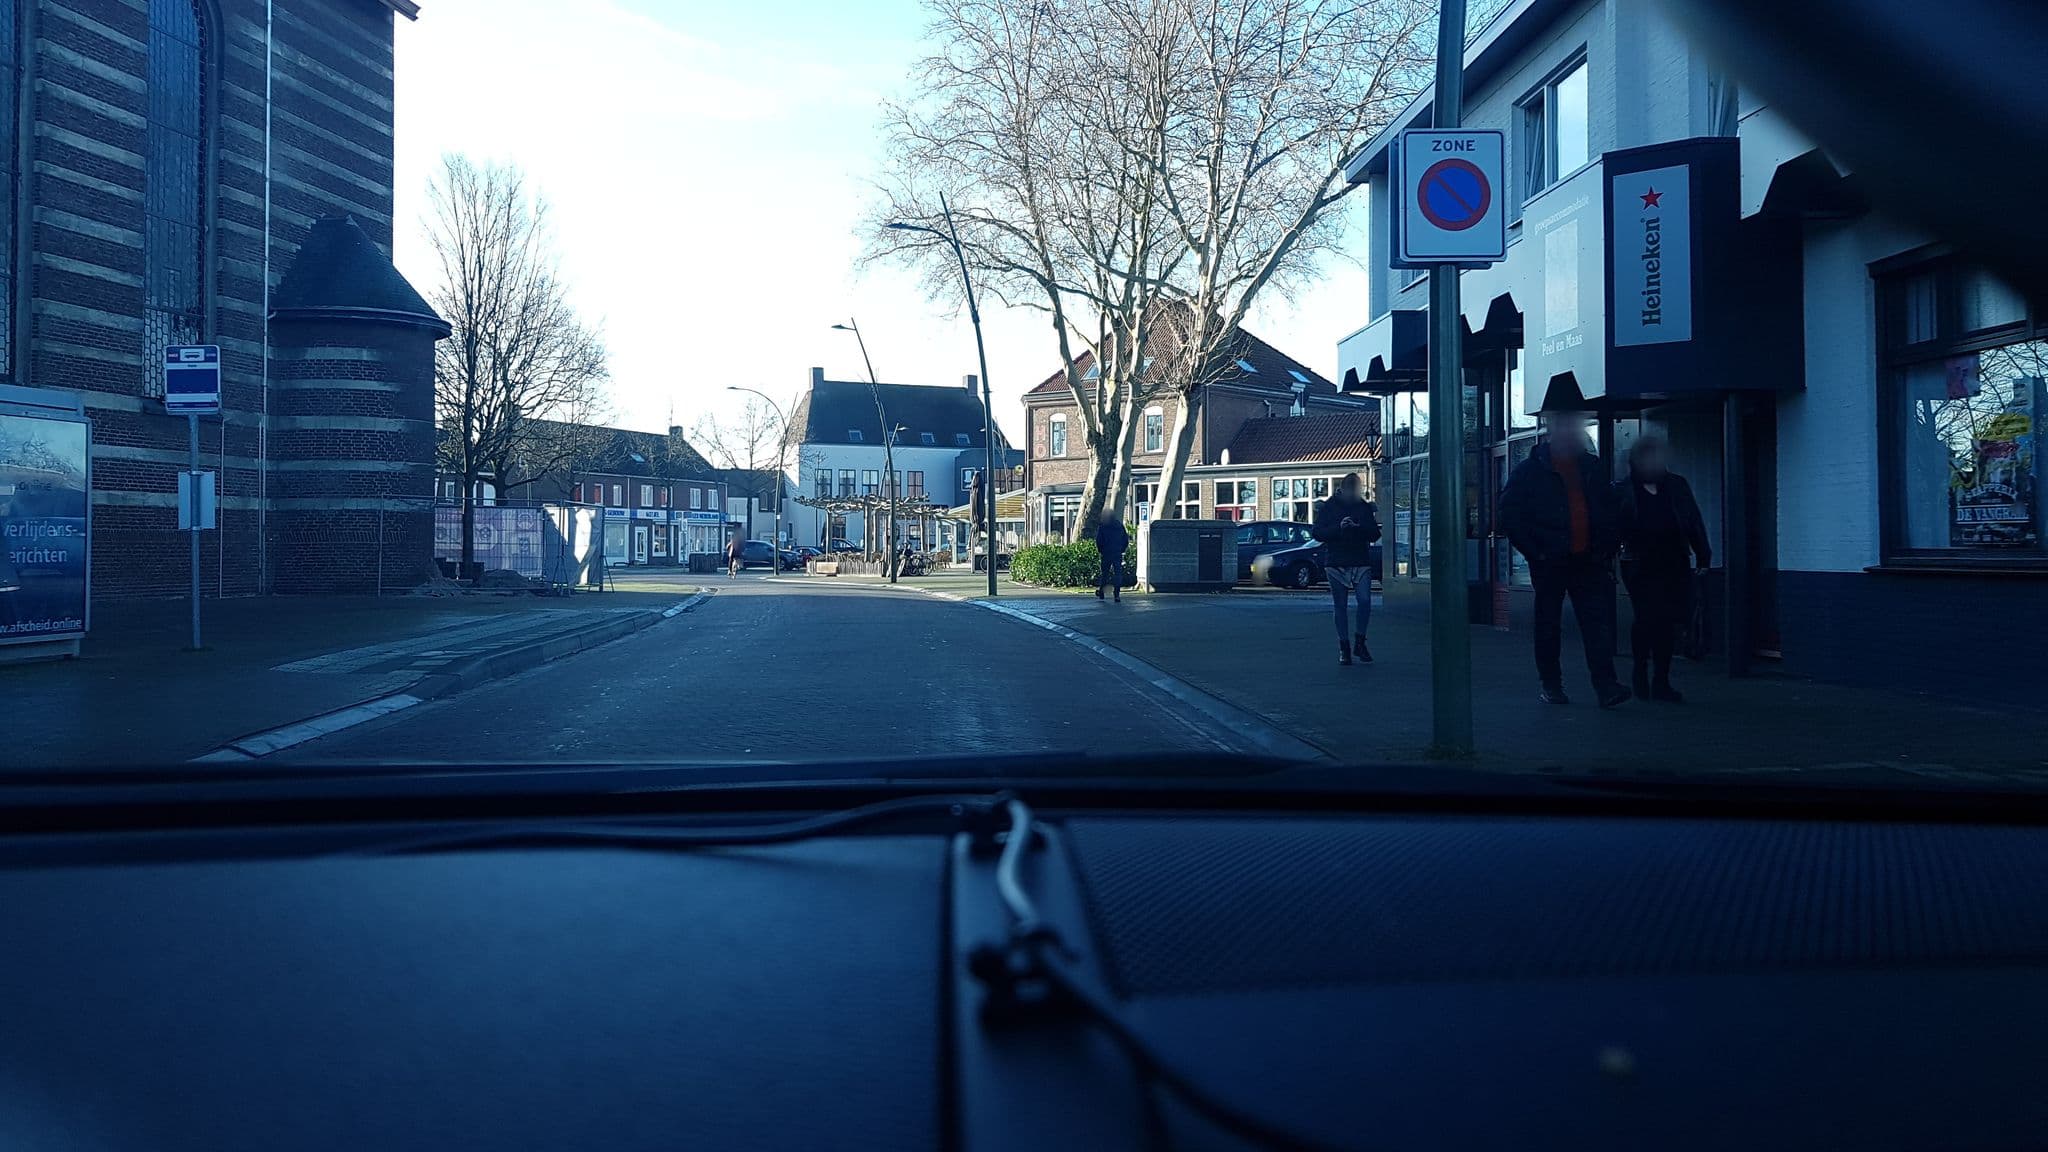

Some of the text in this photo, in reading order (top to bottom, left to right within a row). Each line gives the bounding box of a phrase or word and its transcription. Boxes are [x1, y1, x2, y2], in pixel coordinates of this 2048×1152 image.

[1431, 139, 1476, 152] ZONE
[1641, 216, 1661, 327] Heineken
[1566, 333, 1583, 349] Maas
[9, 547, 68, 563] erichten
